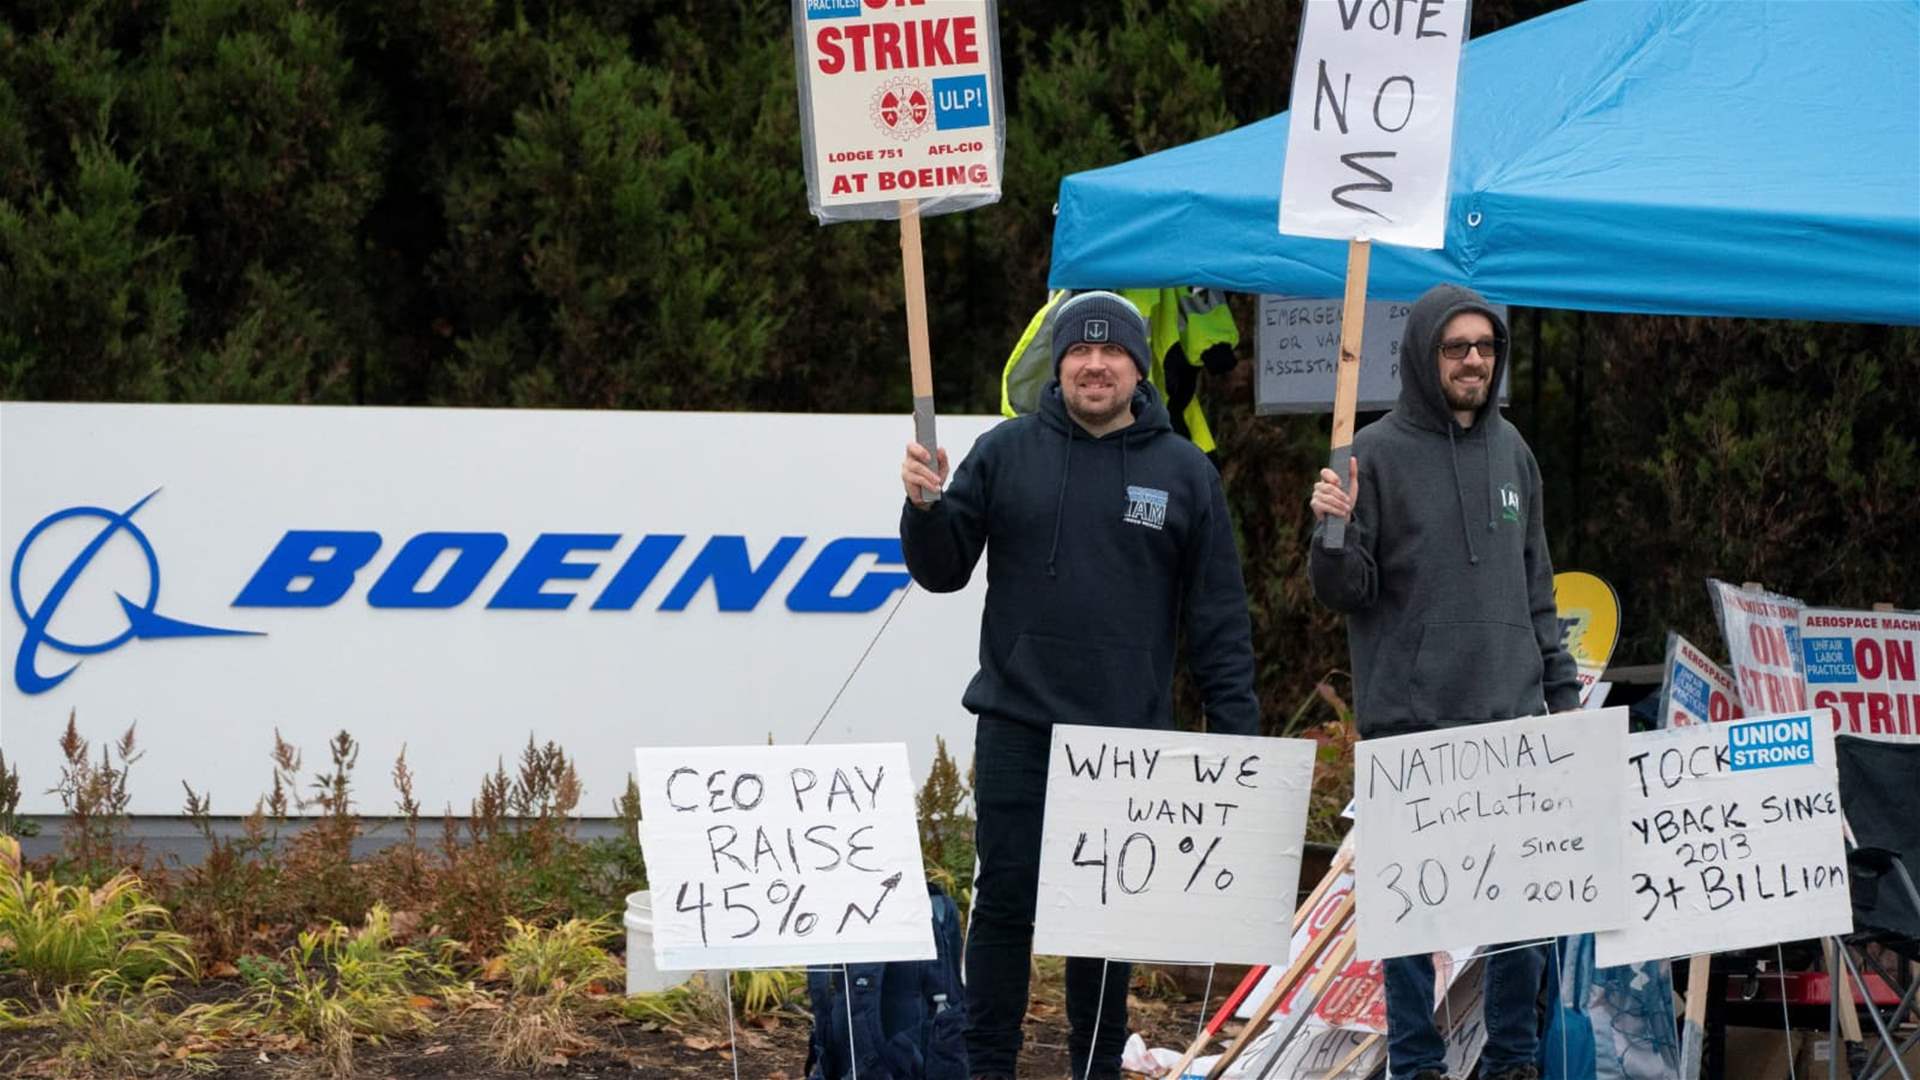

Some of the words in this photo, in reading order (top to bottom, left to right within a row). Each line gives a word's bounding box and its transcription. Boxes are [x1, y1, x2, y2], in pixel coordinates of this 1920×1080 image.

[1338, 0, 1447, 39] VOTE
[817, 16, 979, 75] STRIKE
[939, 87, 983, 111] ULP!
[1314, 59, 1415, 134] NO
[828, 150, 874, 163] LODGE
[879, 149, 904, 160] 751
[928, 142, 983, 156] AFL-CIO
[832, 173, 868, 194] AT
[879, 164, 988, 191] BOEING
[1280, 337, 1302, 350] OR
[230, 530, 912, 613] BOEING
[1806, 616, 1878, 629] AEROSPACE
[1750, 622, 1791, 669] ON
[1815, 651, 1844, 663] LABOR
[1855, 637, 1916, 681] ON
[1733, 720, 1809, 746] UNION
[1065, 743, 1160, 781] WHY
[1194, 754, 1261, 789] WE
[1370, 734, 1575, 800] NATIONAL
[1734, 744, 1810, 766] STRONG
[667, 765, 764, 813] CEO
[790, 765, 885, 813] PAY
[1761, 792, 1836, 824] SINCE
[1127, 797, 1239, 826] WANT
[706, 824, 885, 874] RAISE
[1675, 832, 1752, 867] 2013
[1376, 844, 1501, 923] 30%
[1524, 874, 1599, 903] 2016
[1632, 873, 1685, 921] 3+
[675, 879, 819, 949] 45%
